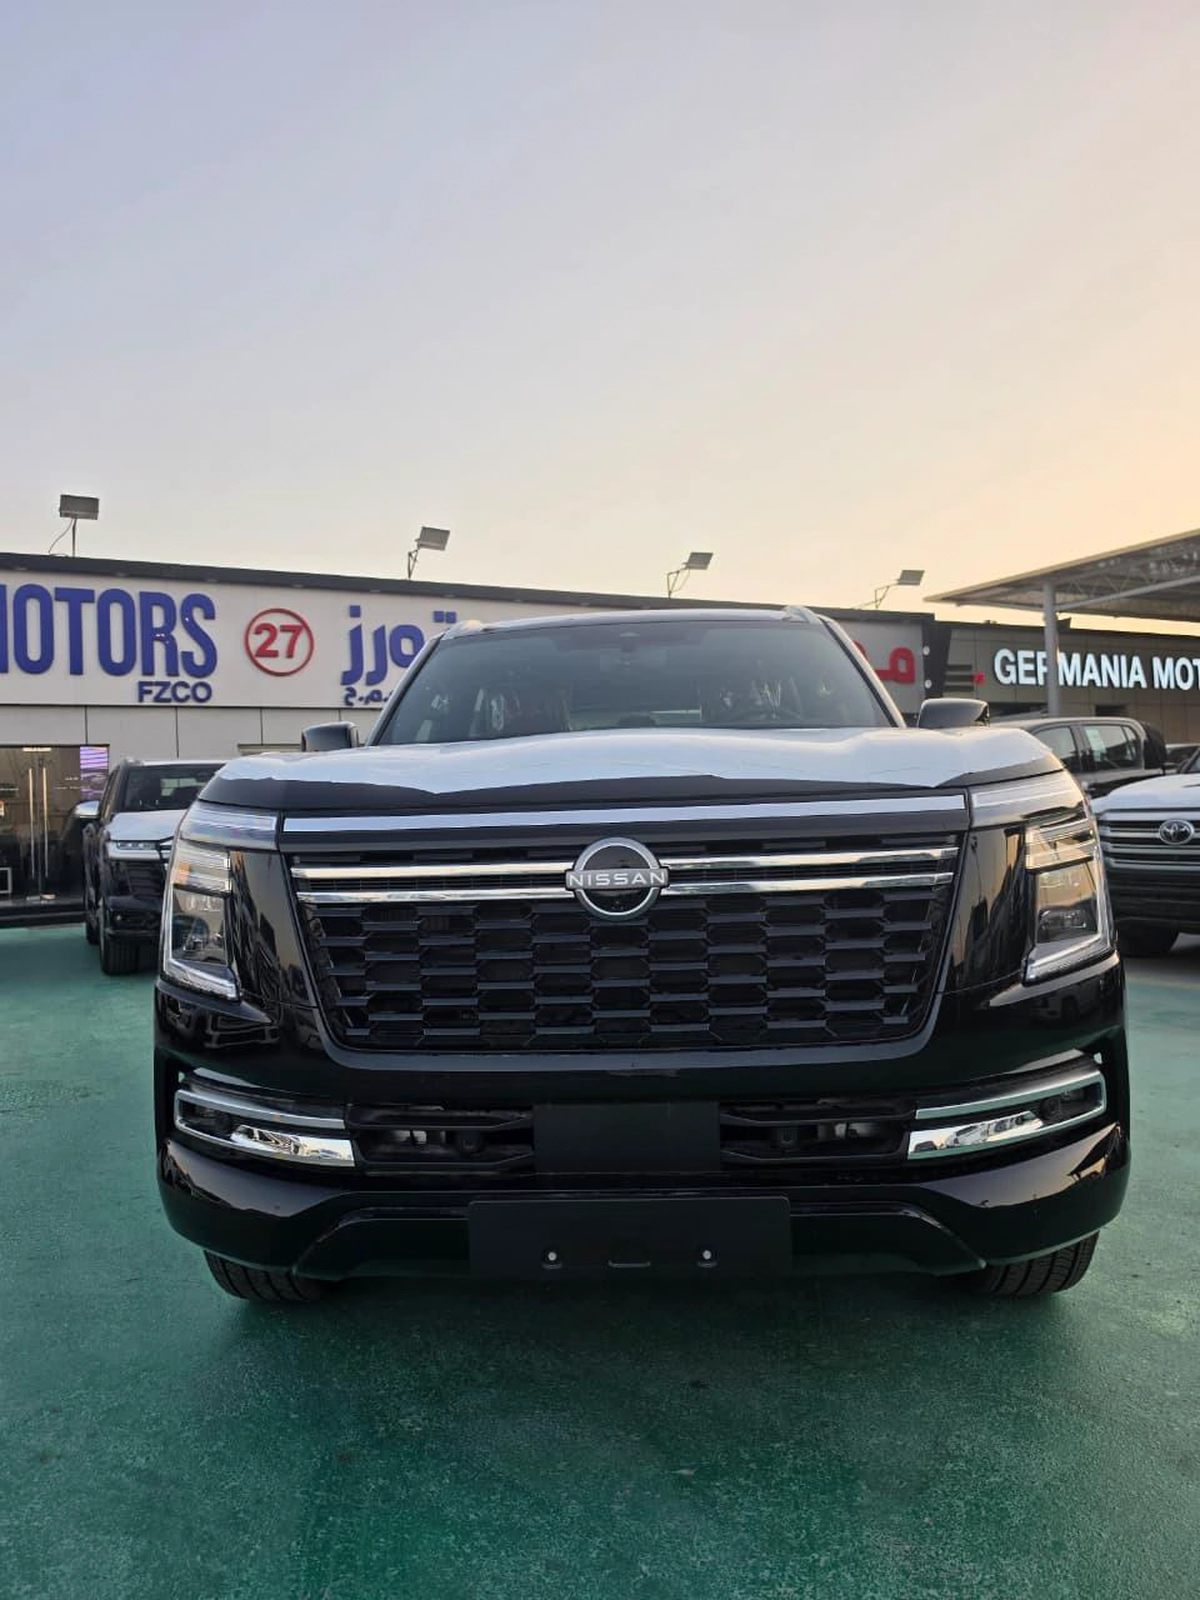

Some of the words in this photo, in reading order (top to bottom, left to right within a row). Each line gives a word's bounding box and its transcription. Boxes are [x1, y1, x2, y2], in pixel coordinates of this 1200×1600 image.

[0, 583, 218, 678] OTORS
[253, 623, 302, 659] 27
[138, 681, 213, 703] FZCO
[569, 872, 665, 887] NISSAN
